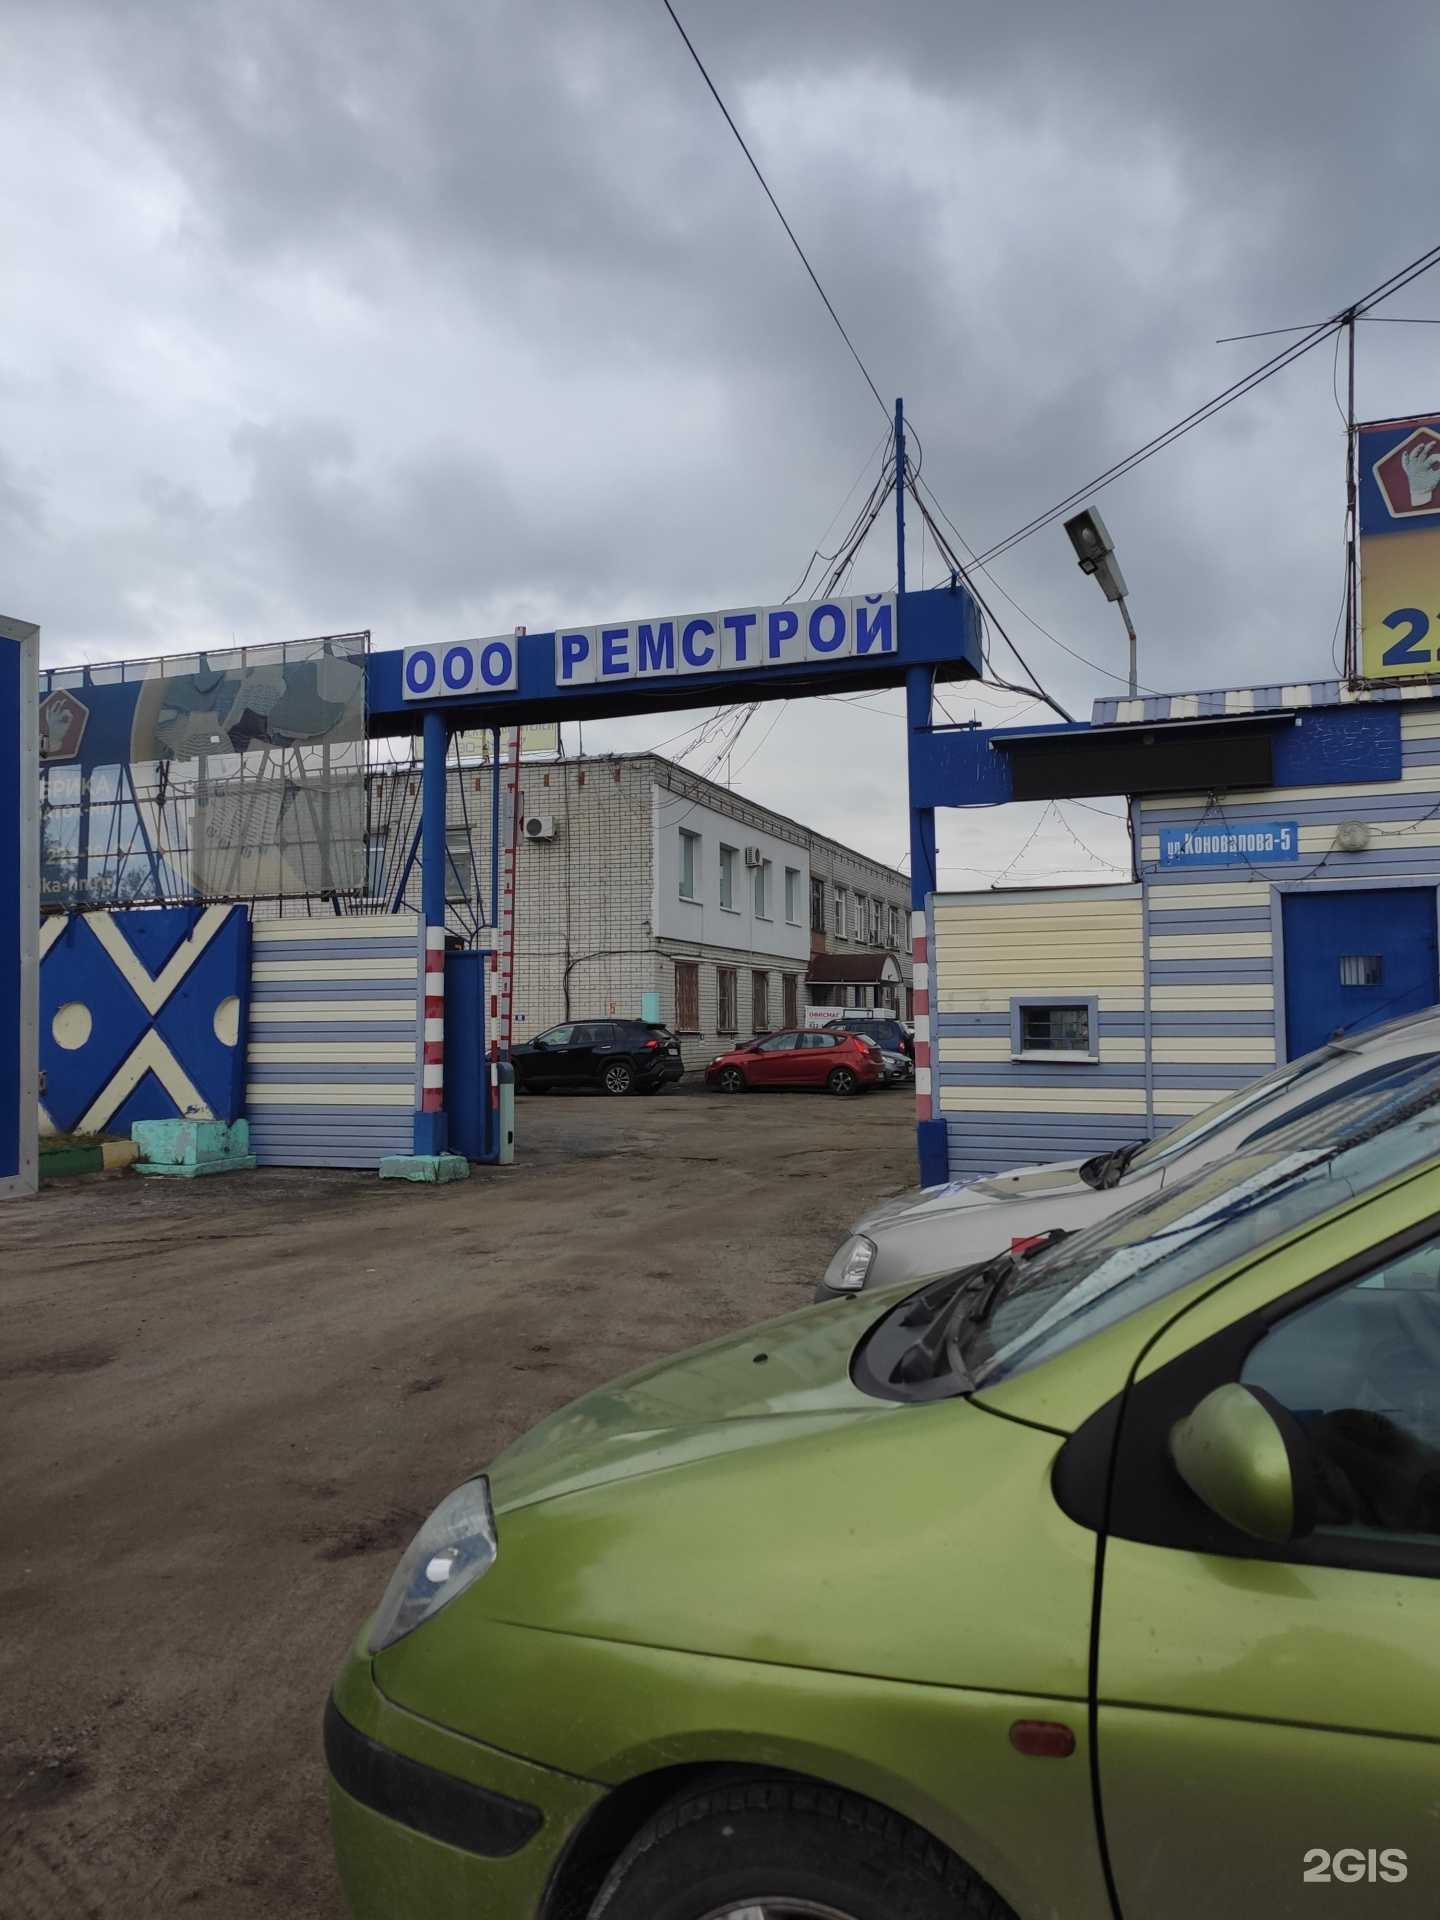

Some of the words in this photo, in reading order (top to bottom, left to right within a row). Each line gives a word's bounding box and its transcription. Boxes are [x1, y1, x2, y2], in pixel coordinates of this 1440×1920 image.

[405, 642, 512, 695] ООО
[561, 592, 892, 680] РЕМСТРОЙ
[1381, 607, 1440, 666] 2
